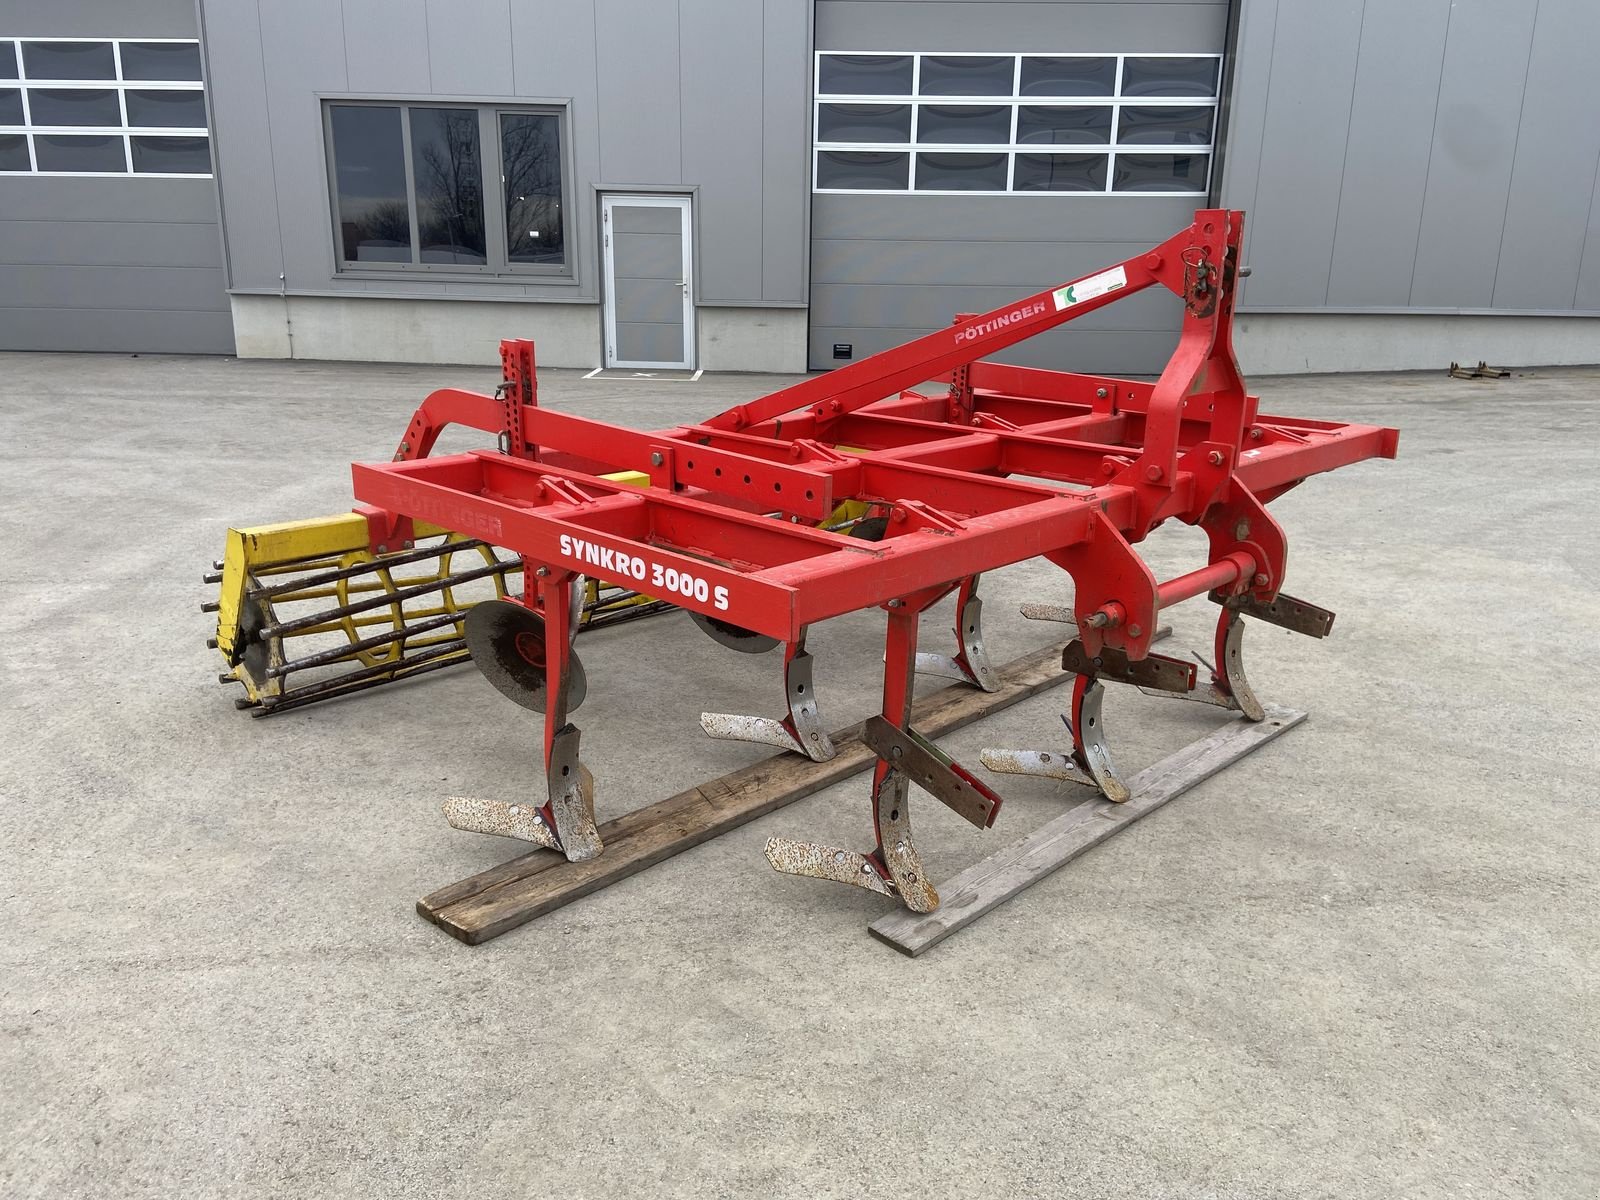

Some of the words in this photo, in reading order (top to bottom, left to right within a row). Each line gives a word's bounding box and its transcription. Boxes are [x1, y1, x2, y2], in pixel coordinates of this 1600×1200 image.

[954, 301, 1046, 345] PÖTTINGER
[559, 533, 646, 581] SYNKRO
[651, 562, 709, 603] 3000
[714, 585, 729, 611] S
